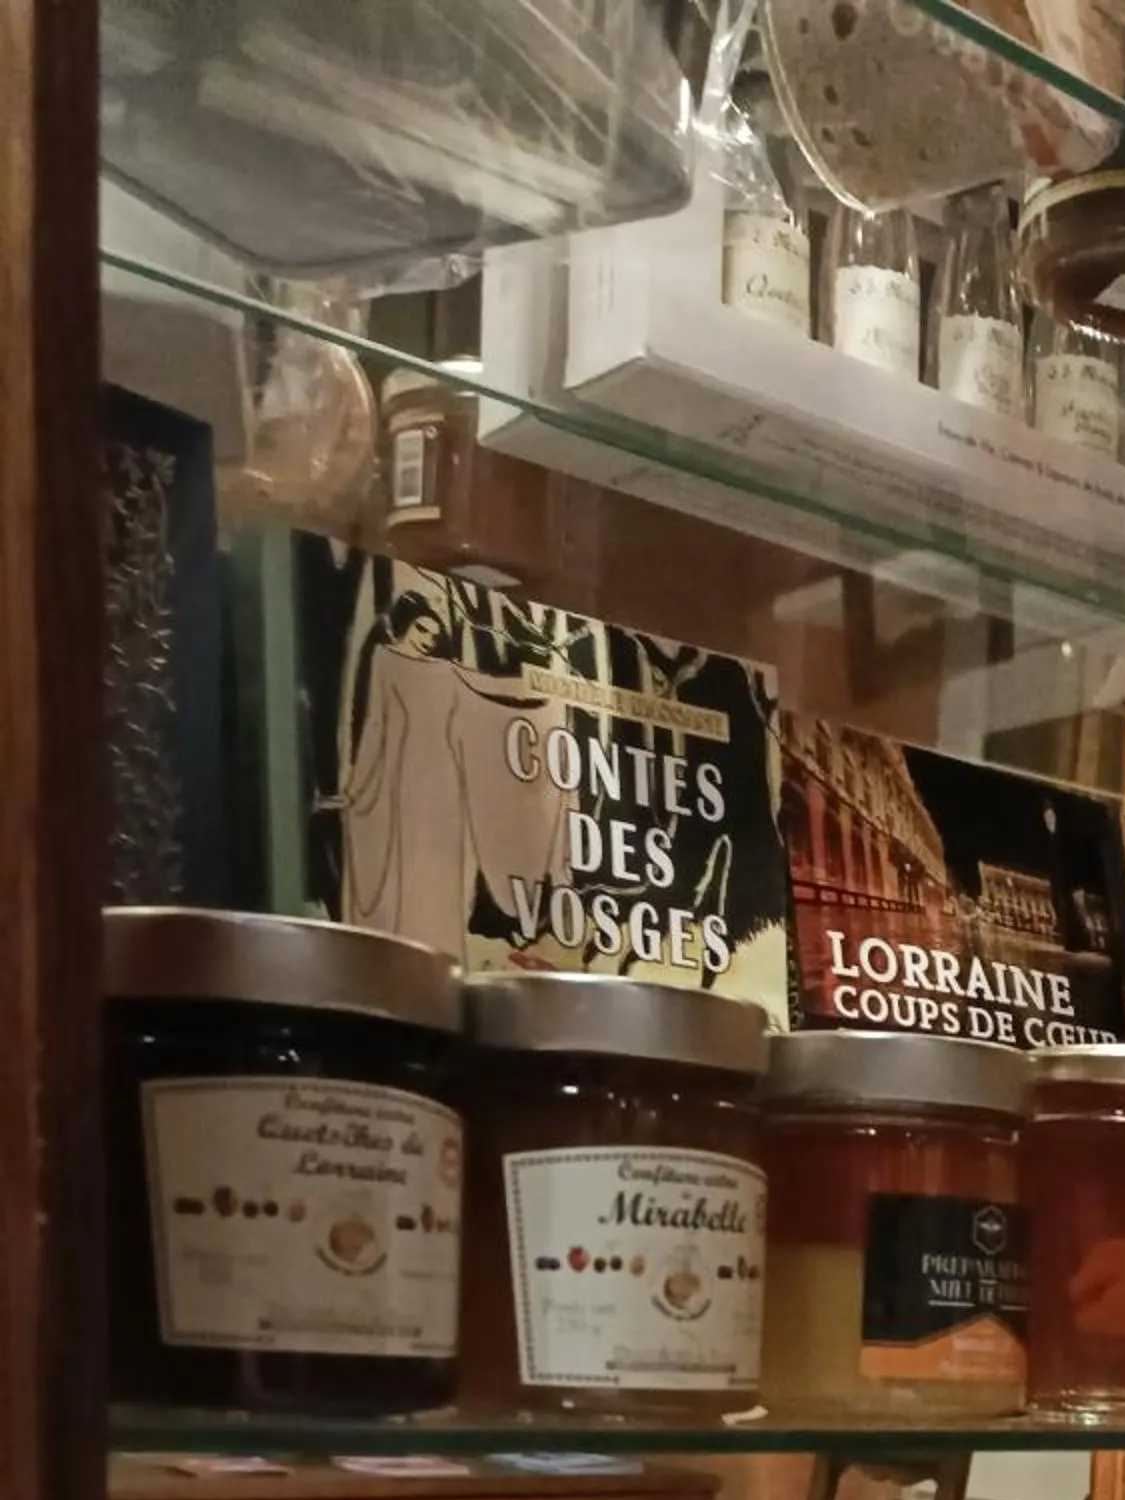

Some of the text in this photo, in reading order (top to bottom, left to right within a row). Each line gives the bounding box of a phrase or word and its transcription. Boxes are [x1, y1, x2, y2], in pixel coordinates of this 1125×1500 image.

[506, 716, 726, 824] CONTES
[568, 809, 677, 889] DES
[509, 875, 731, 975] VOSGES
[826, 930, 1075, 1017] LORRAINE
[833, 985, 961, 1034] COUPS
[967, 1006, 1017, 1043] DE
[597, 1190, 747, 1234] Mirabelle
[617, 1158, 700, 1187] Confiture
